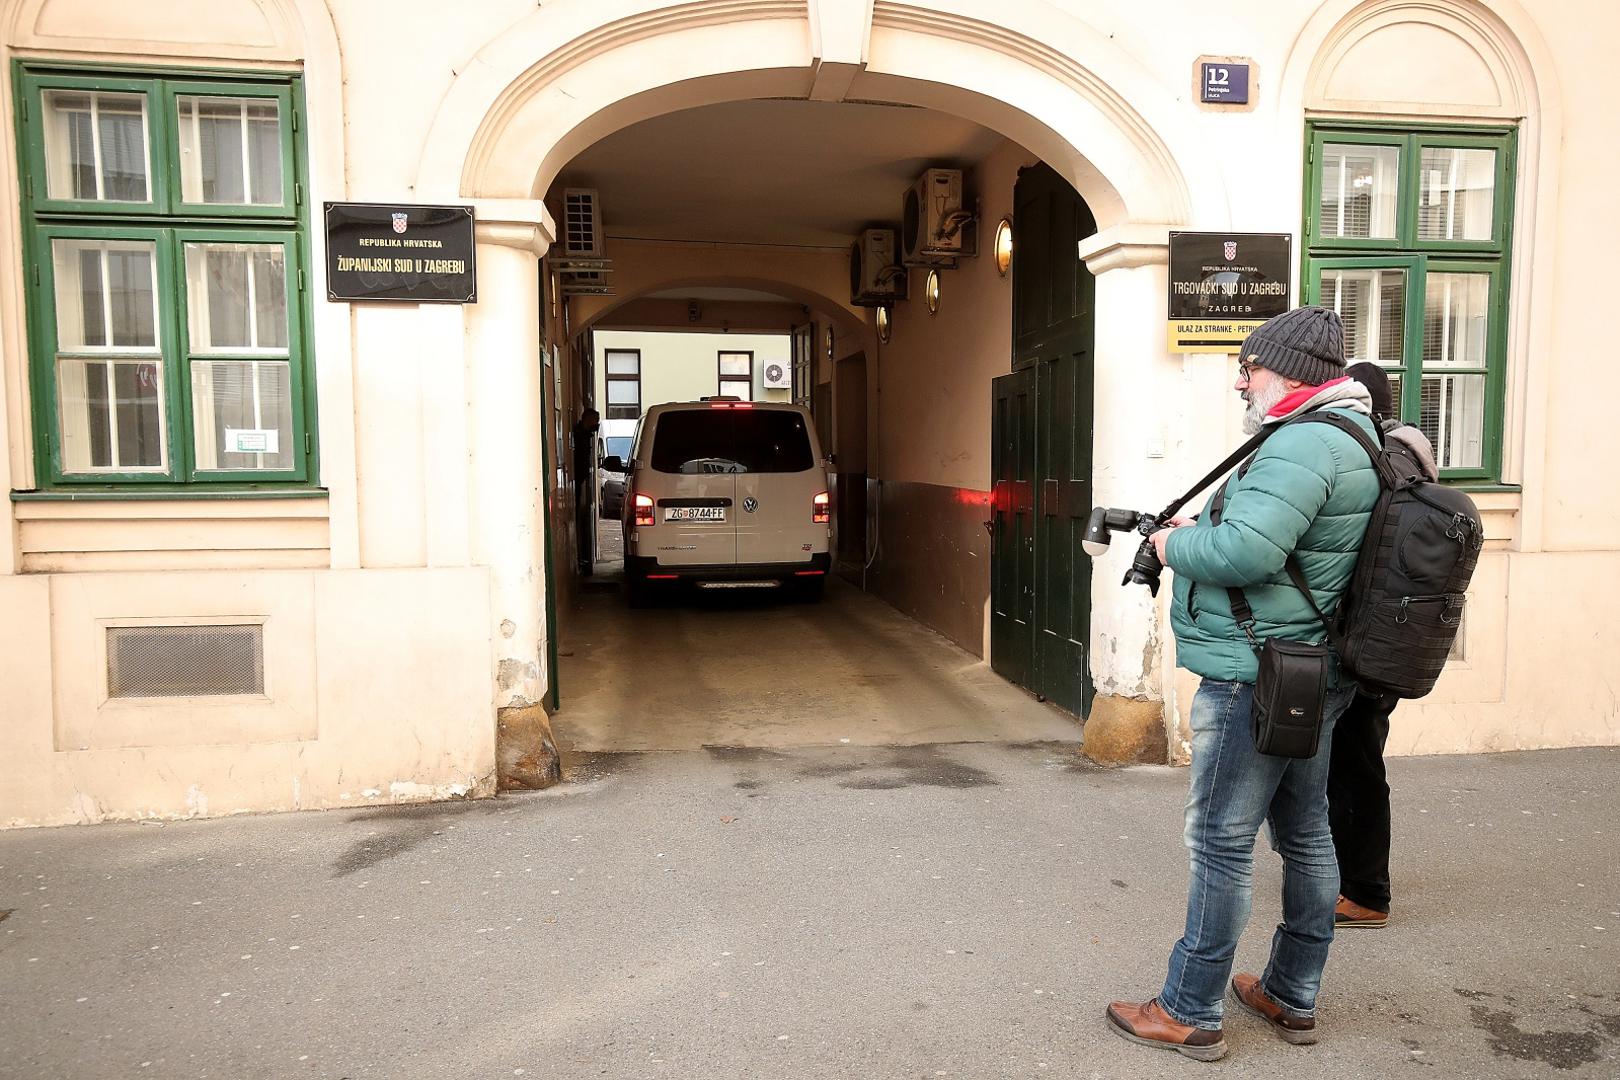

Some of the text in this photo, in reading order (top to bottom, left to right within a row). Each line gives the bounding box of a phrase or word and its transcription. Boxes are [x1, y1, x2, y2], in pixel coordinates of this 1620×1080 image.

[1208, 68, 1229, 85] 12
[359, 238, 443, 248] REPUBLIKA HRVATSKA
[337, 255, 465, 274] ŽUPANIJSKI SUD U ZAGREBU
[1173, 280, 1287, 295] TRGOVAČKI SUD U ZAGREBU
[1177, 325, 1193, 333] ULAZ
[1194, 325, 1203, 333] ZA
[1204, 325, 1232, 333] STRANKE
[1237, 325, 1257, 333] PETRI
[671, 508, 683, 518] ZG
